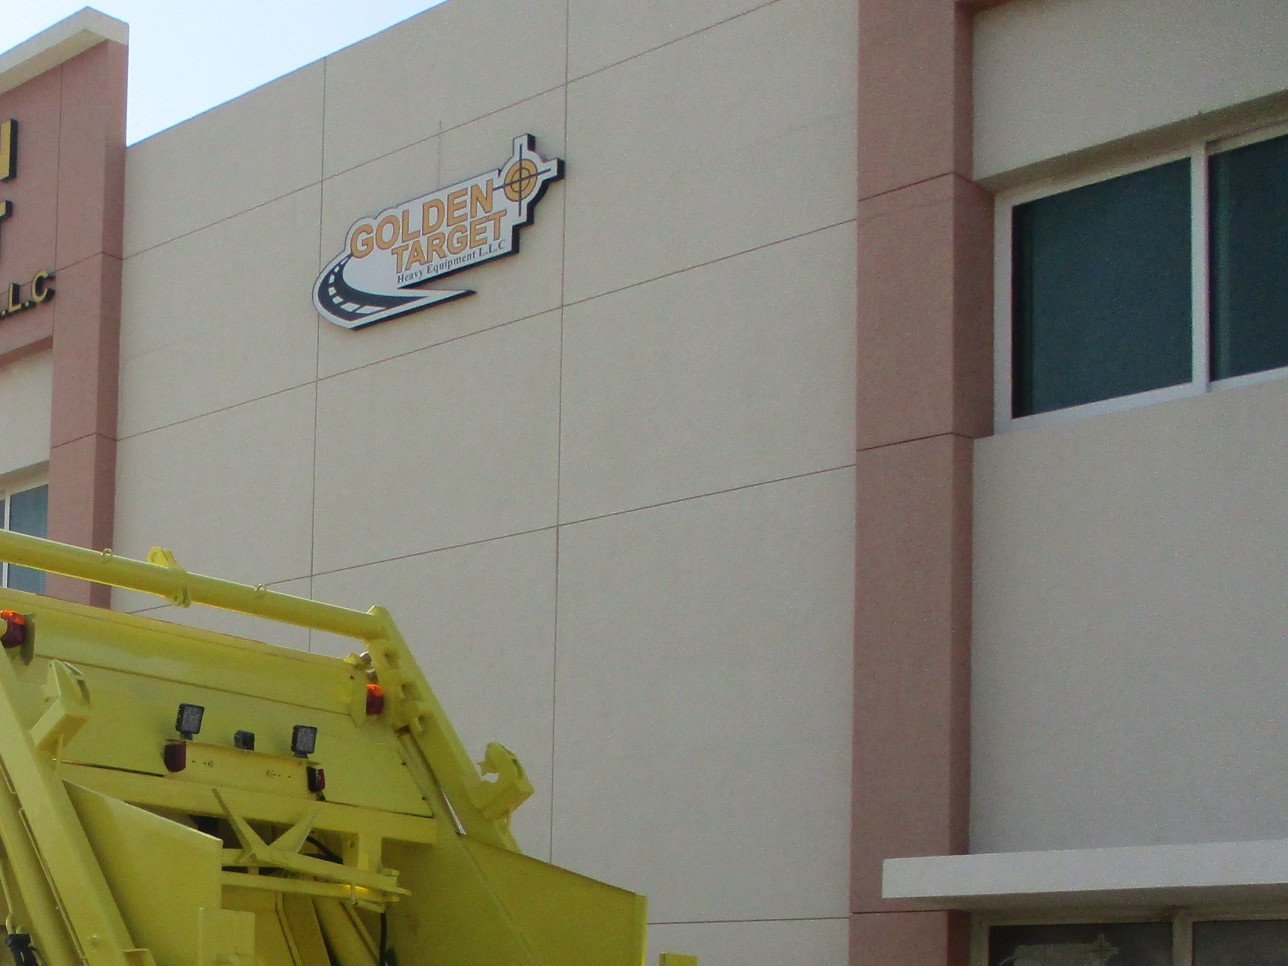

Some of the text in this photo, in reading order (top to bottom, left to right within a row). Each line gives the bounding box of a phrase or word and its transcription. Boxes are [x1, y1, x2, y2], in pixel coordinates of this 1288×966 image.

[350, 178, 494, 258] GOLDEN
[391, 208, 508, 274] TARGET
[397, 239, 506, 284] Heavy Equipment L.L.C
